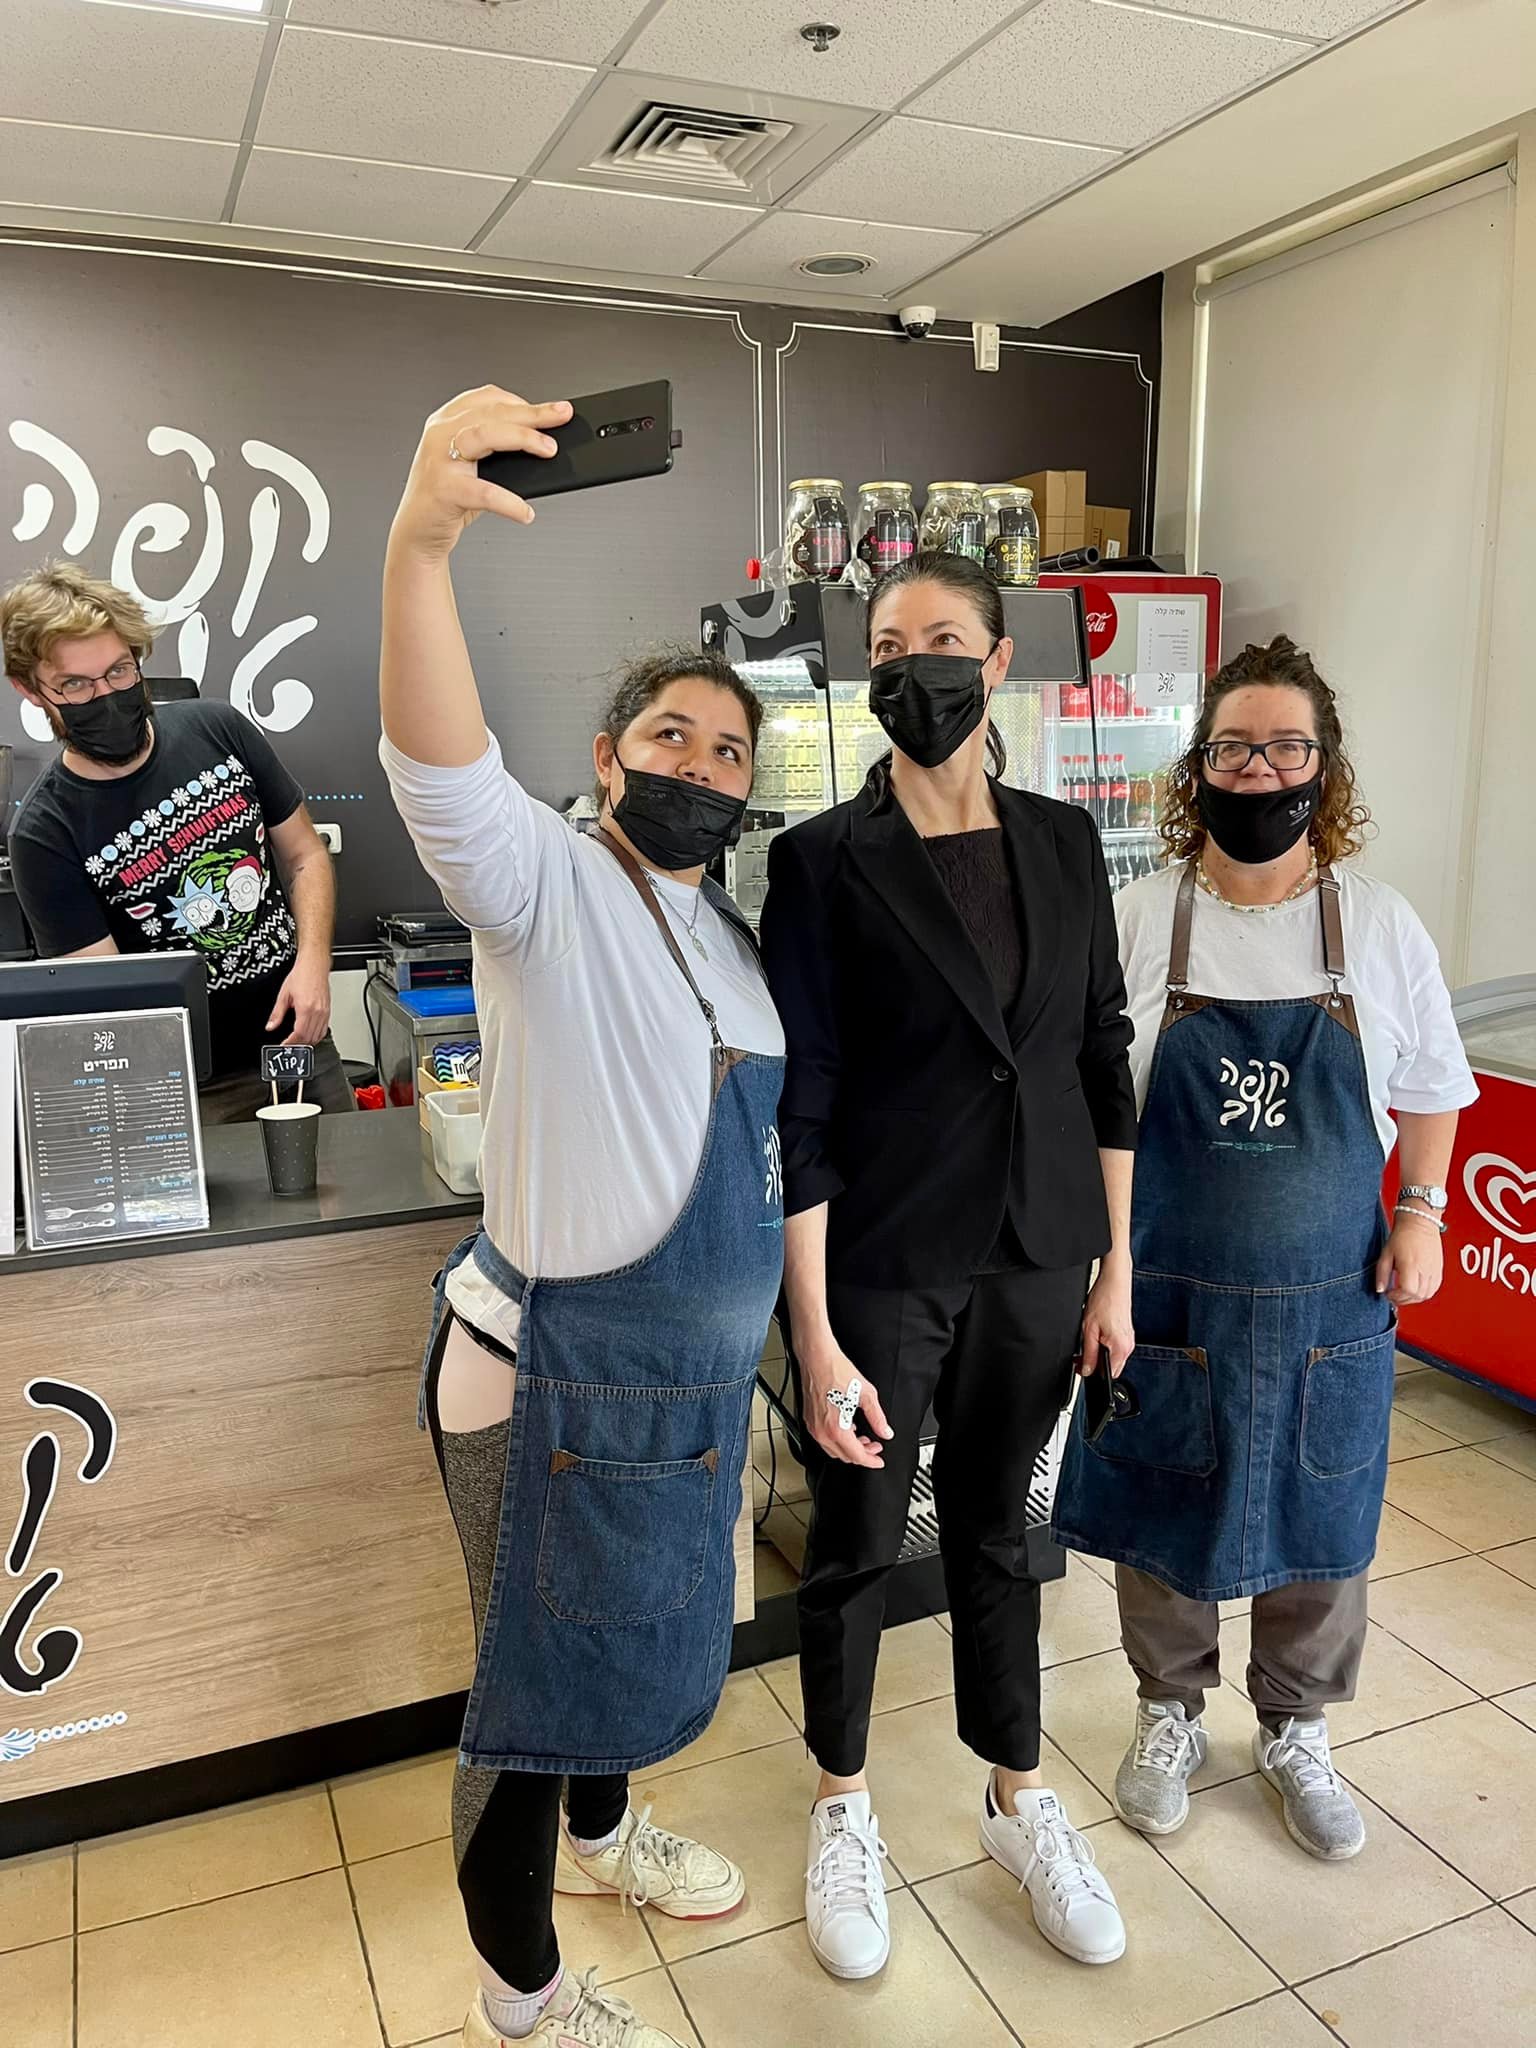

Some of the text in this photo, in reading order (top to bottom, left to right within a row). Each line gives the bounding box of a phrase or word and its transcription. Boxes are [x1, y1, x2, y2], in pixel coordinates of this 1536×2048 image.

[8, 420, 330, 638] קפה
[118, 793, 248, 888] MERRY SCHWIFTMAS
[83, 1058, 129, 1073] תפריט
[273, 1052, 298, 1072] Tip
[1219, 1057, 1290, 1104] קפה
[1219, 1098, 1287, 1132] טוב
